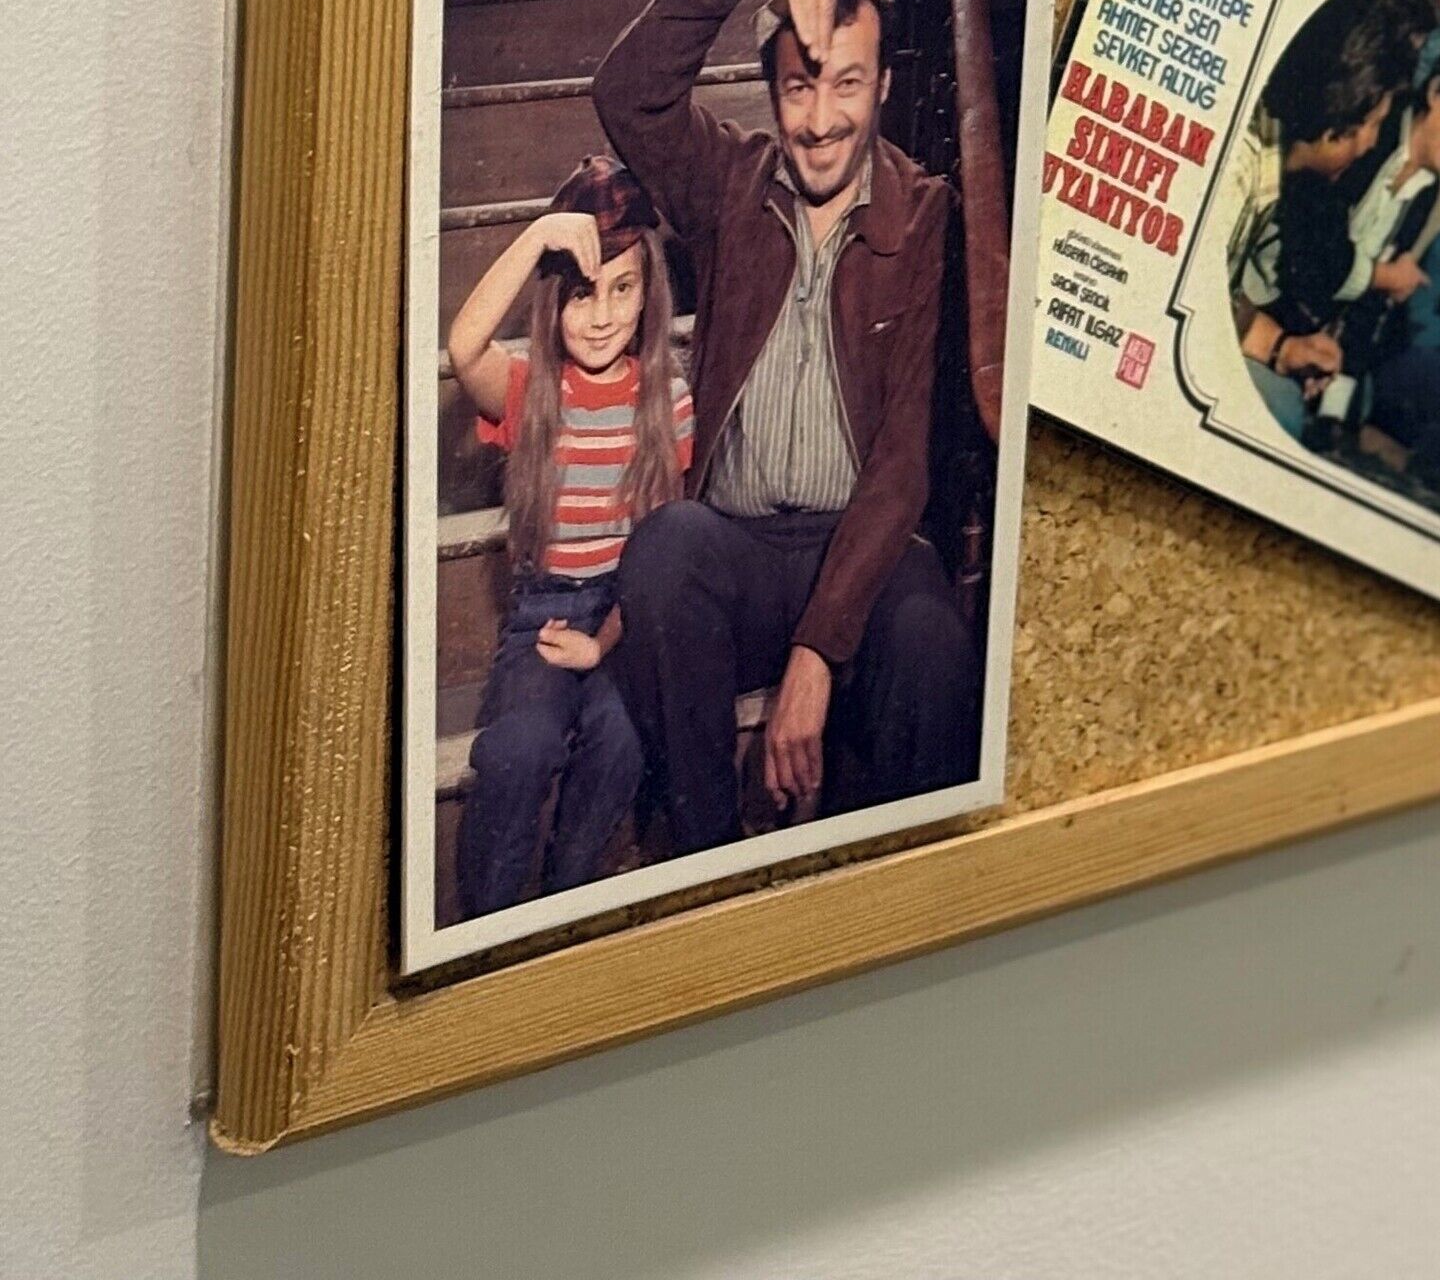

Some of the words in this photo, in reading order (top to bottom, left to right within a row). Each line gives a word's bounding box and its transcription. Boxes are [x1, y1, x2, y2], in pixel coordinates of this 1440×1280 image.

[1158, 28, 1228, 86] SEZEREL
[1061, 59, 1216, 169] HABABAM
[1158, 64, 1216, 110] ALTUĞ
[1066, 115, 1179, 204] SINIFI
[1047, 297, 1085, 328] RIFAT
